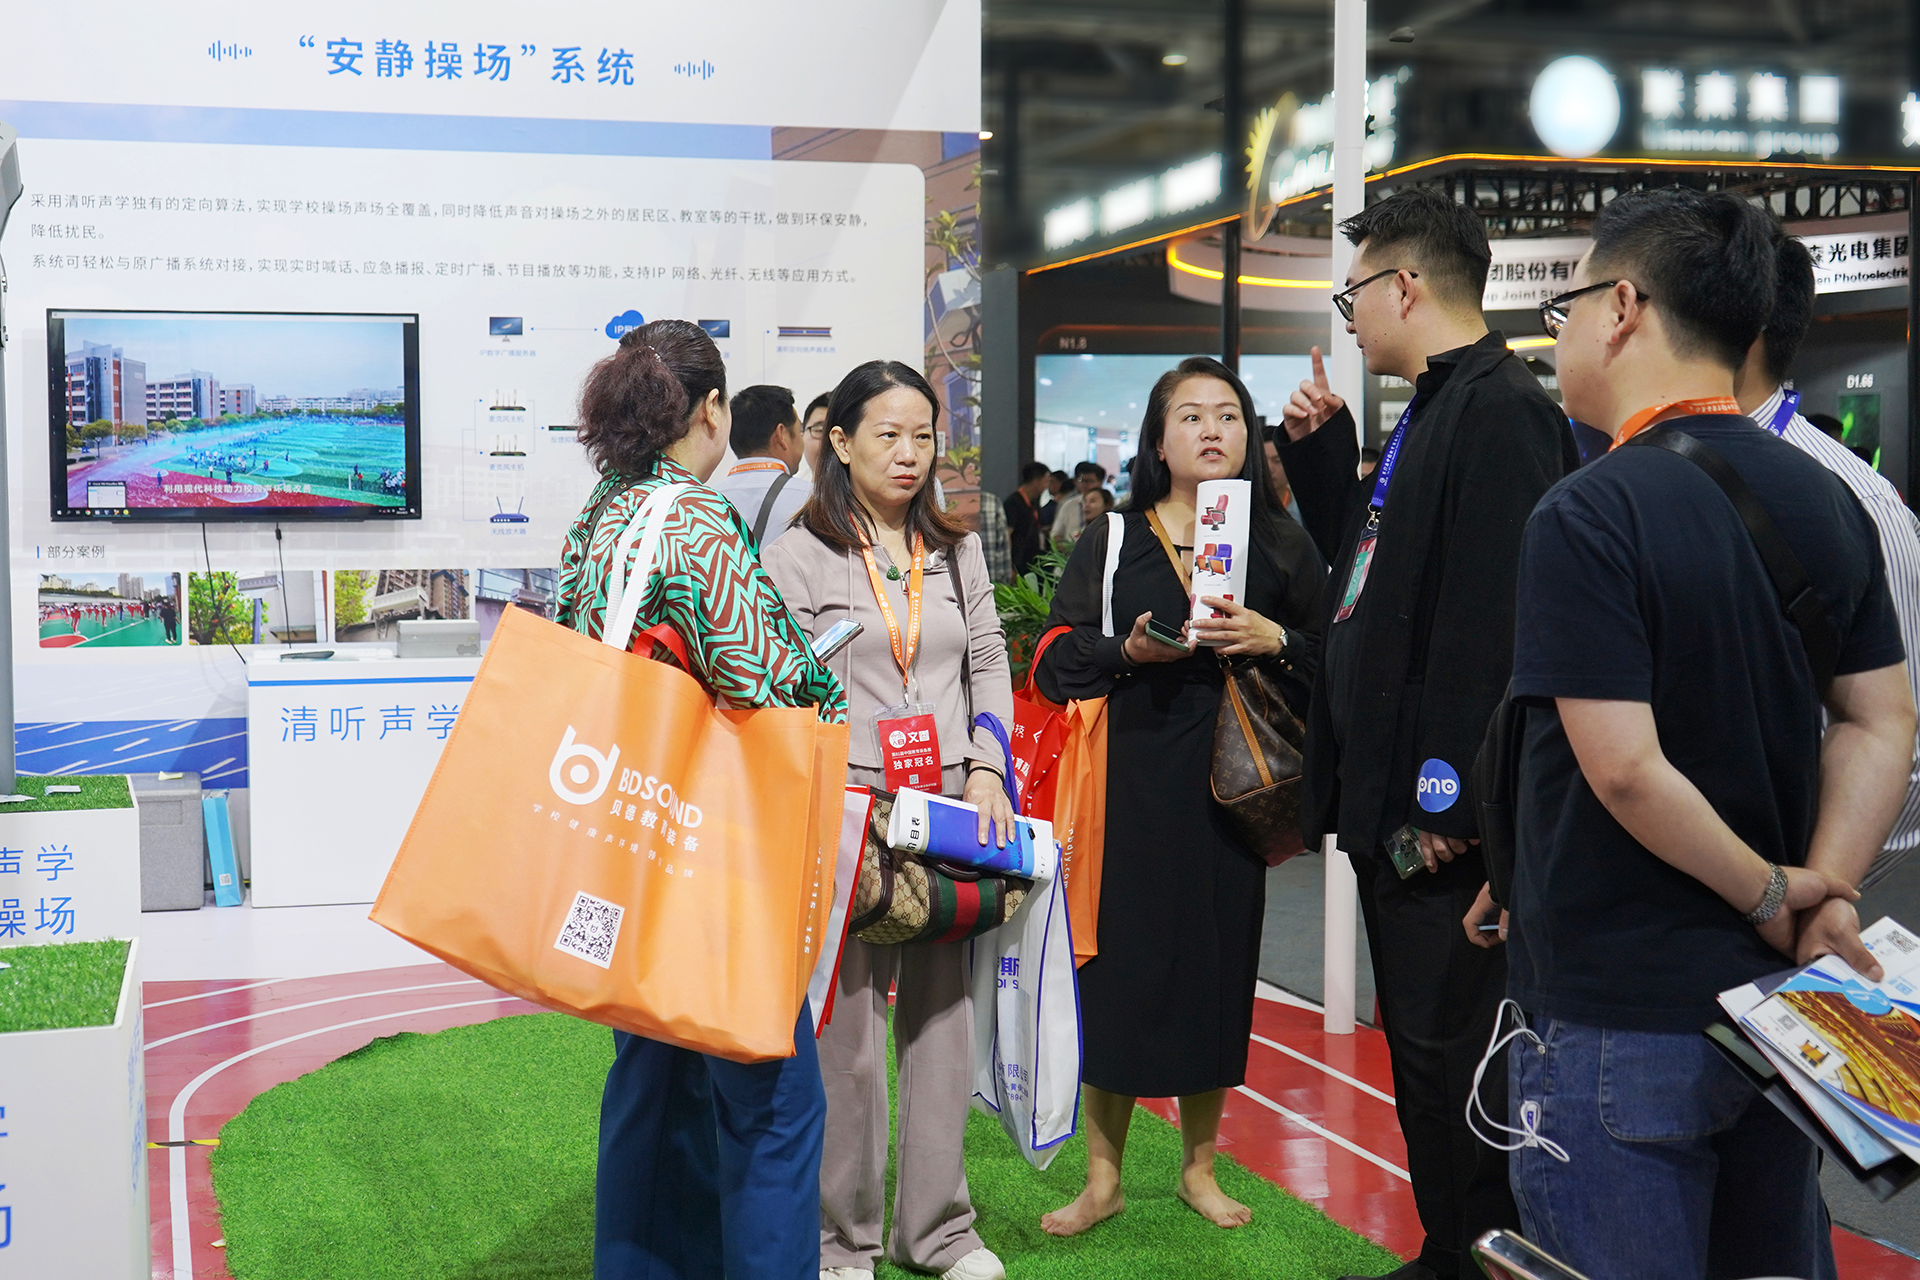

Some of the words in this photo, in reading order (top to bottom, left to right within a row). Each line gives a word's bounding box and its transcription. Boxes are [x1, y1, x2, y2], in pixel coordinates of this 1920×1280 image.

[31, 223, 105, 239] 降低扰民。
[1502, 289, 1536, 301] Joint
[1058, 336, 1088, 350] N1.8
[1846, 373, 1874, 389] D1.66
[46, 544, 106, 560] 部分案例
[280, 704, 461, 743] 清听声学
[892, 756, 934, 771] 独家冠名
[617, 767, 703, 829] BDSOUND
